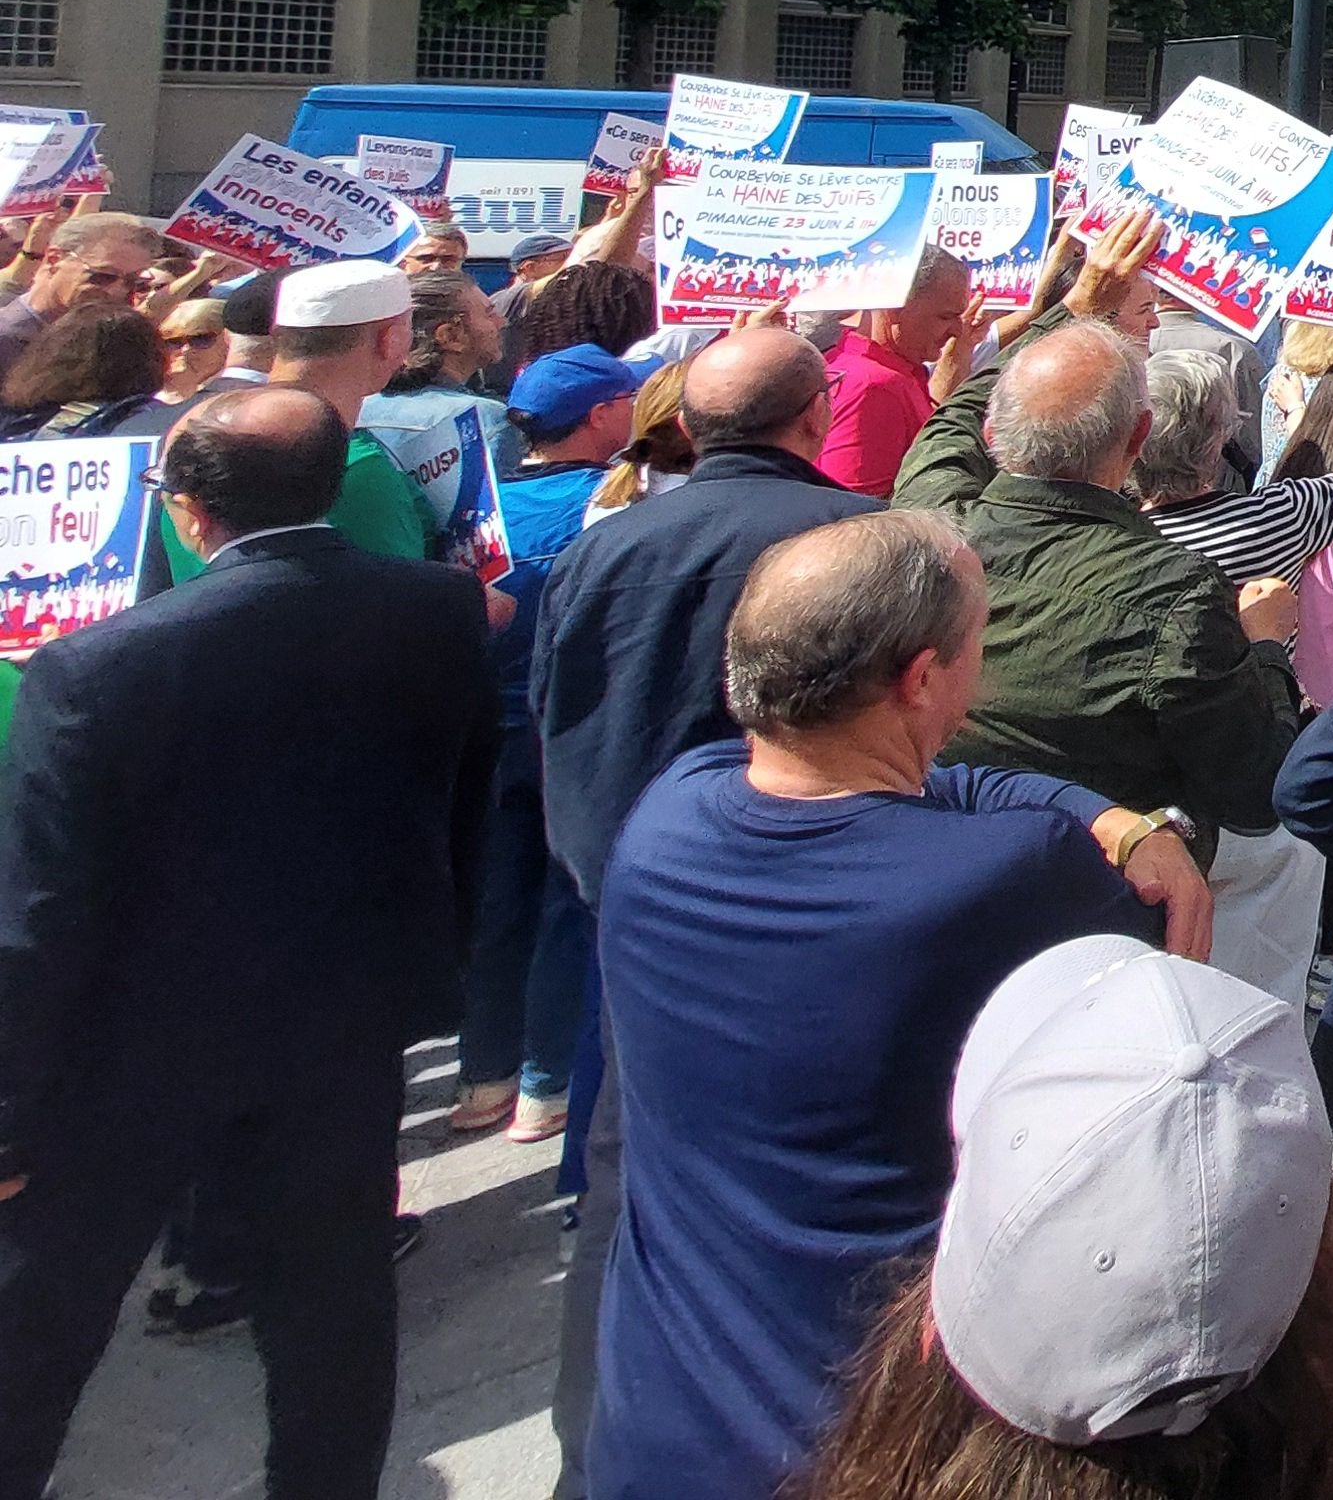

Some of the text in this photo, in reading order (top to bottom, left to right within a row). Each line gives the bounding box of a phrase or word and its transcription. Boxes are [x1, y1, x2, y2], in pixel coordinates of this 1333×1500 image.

[242, 142, 399, 227] Les enfants
[796, 173, 815, 186] SE
[818, 170, 852, 186] LÈVE
[480, 186, 535, 197] seit 1891
[706, 185, 725, 199] LA
[733, 182, 791, 207] HAINE
[795, 191, 823, 205] DES
[951, 185, 1000, 203] nous
[211, 172, 349, 245] innocents
[696, 211, 781, 229] DIMANCHE
[782, 217, 806, 229] 23
[936, 224, 982, 248] face
[67, 459, 111, 501] pas
[50, 500, 100, 551] feuj
